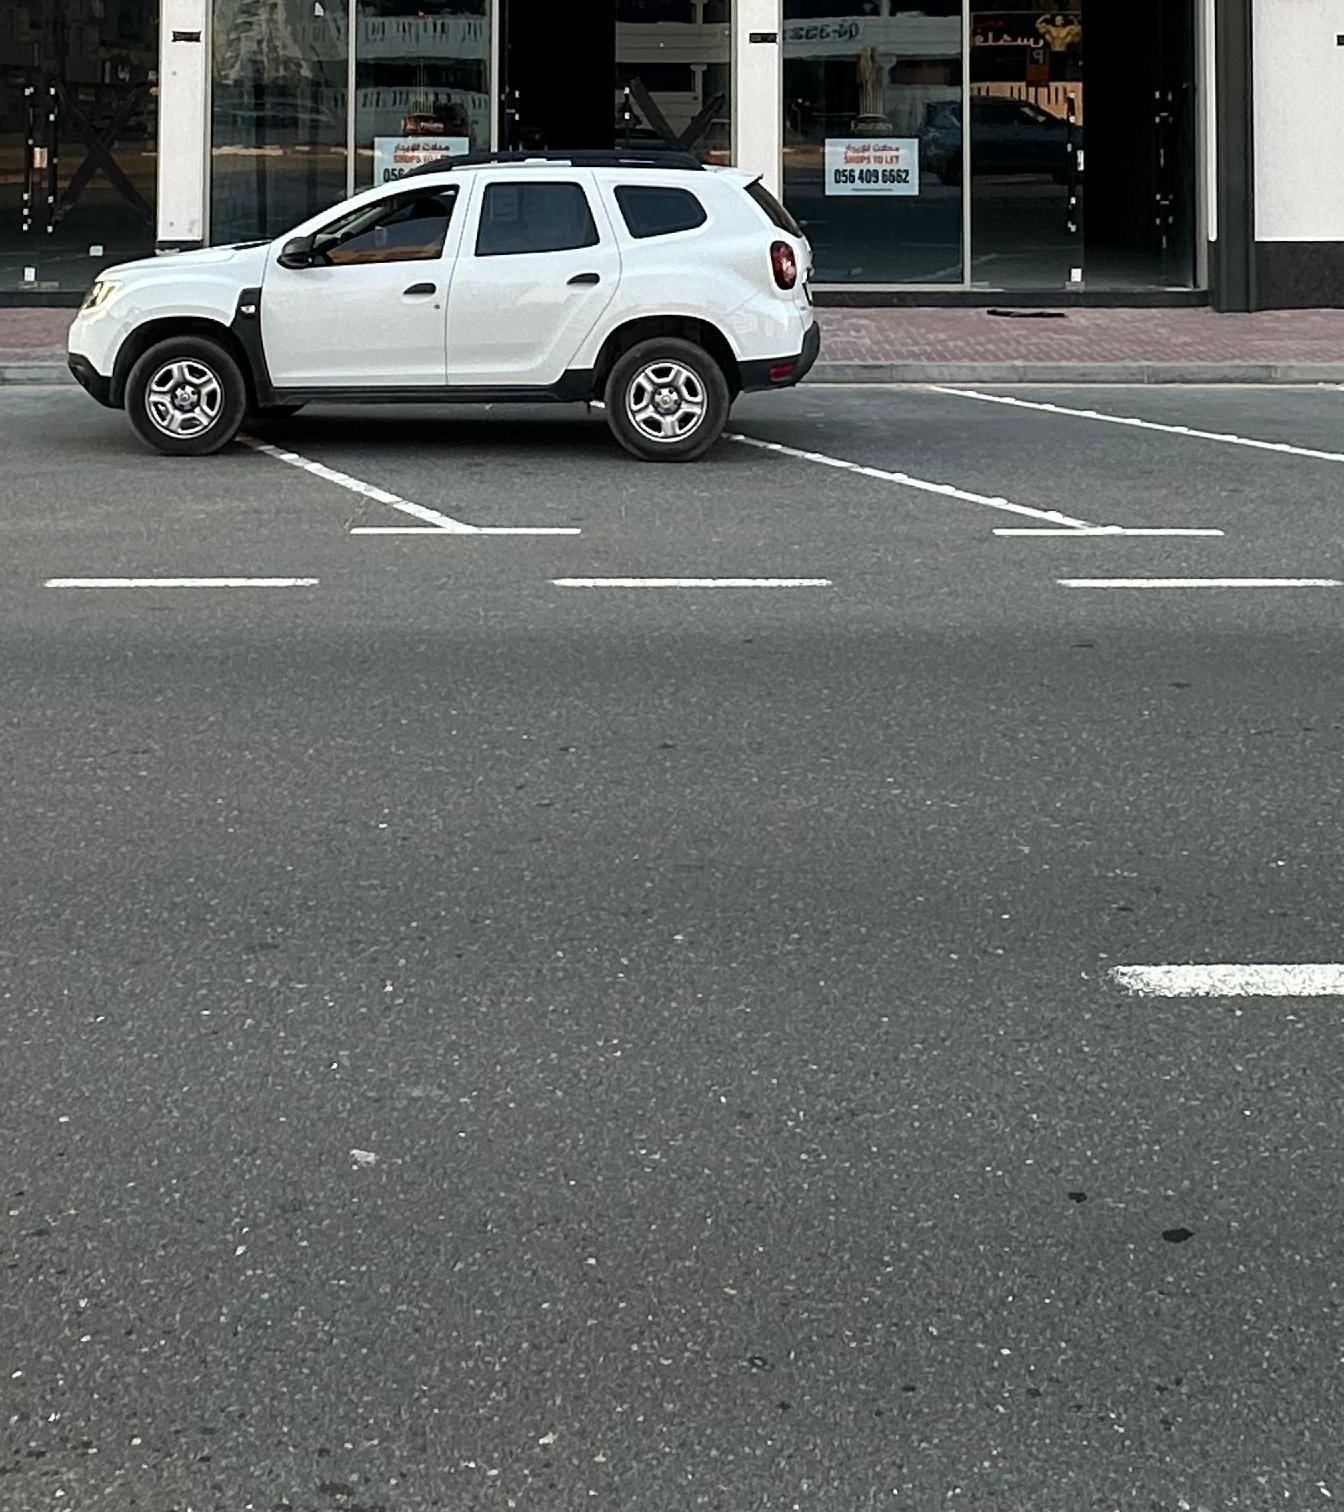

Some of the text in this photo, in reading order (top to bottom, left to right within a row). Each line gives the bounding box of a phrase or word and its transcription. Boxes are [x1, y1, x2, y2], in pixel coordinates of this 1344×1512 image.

[873, 155, 884, 164] TO
[885, 155, 900, 164] LET
[834, 168, 856, 184] 056
[857, 168, 880, 184] 409
